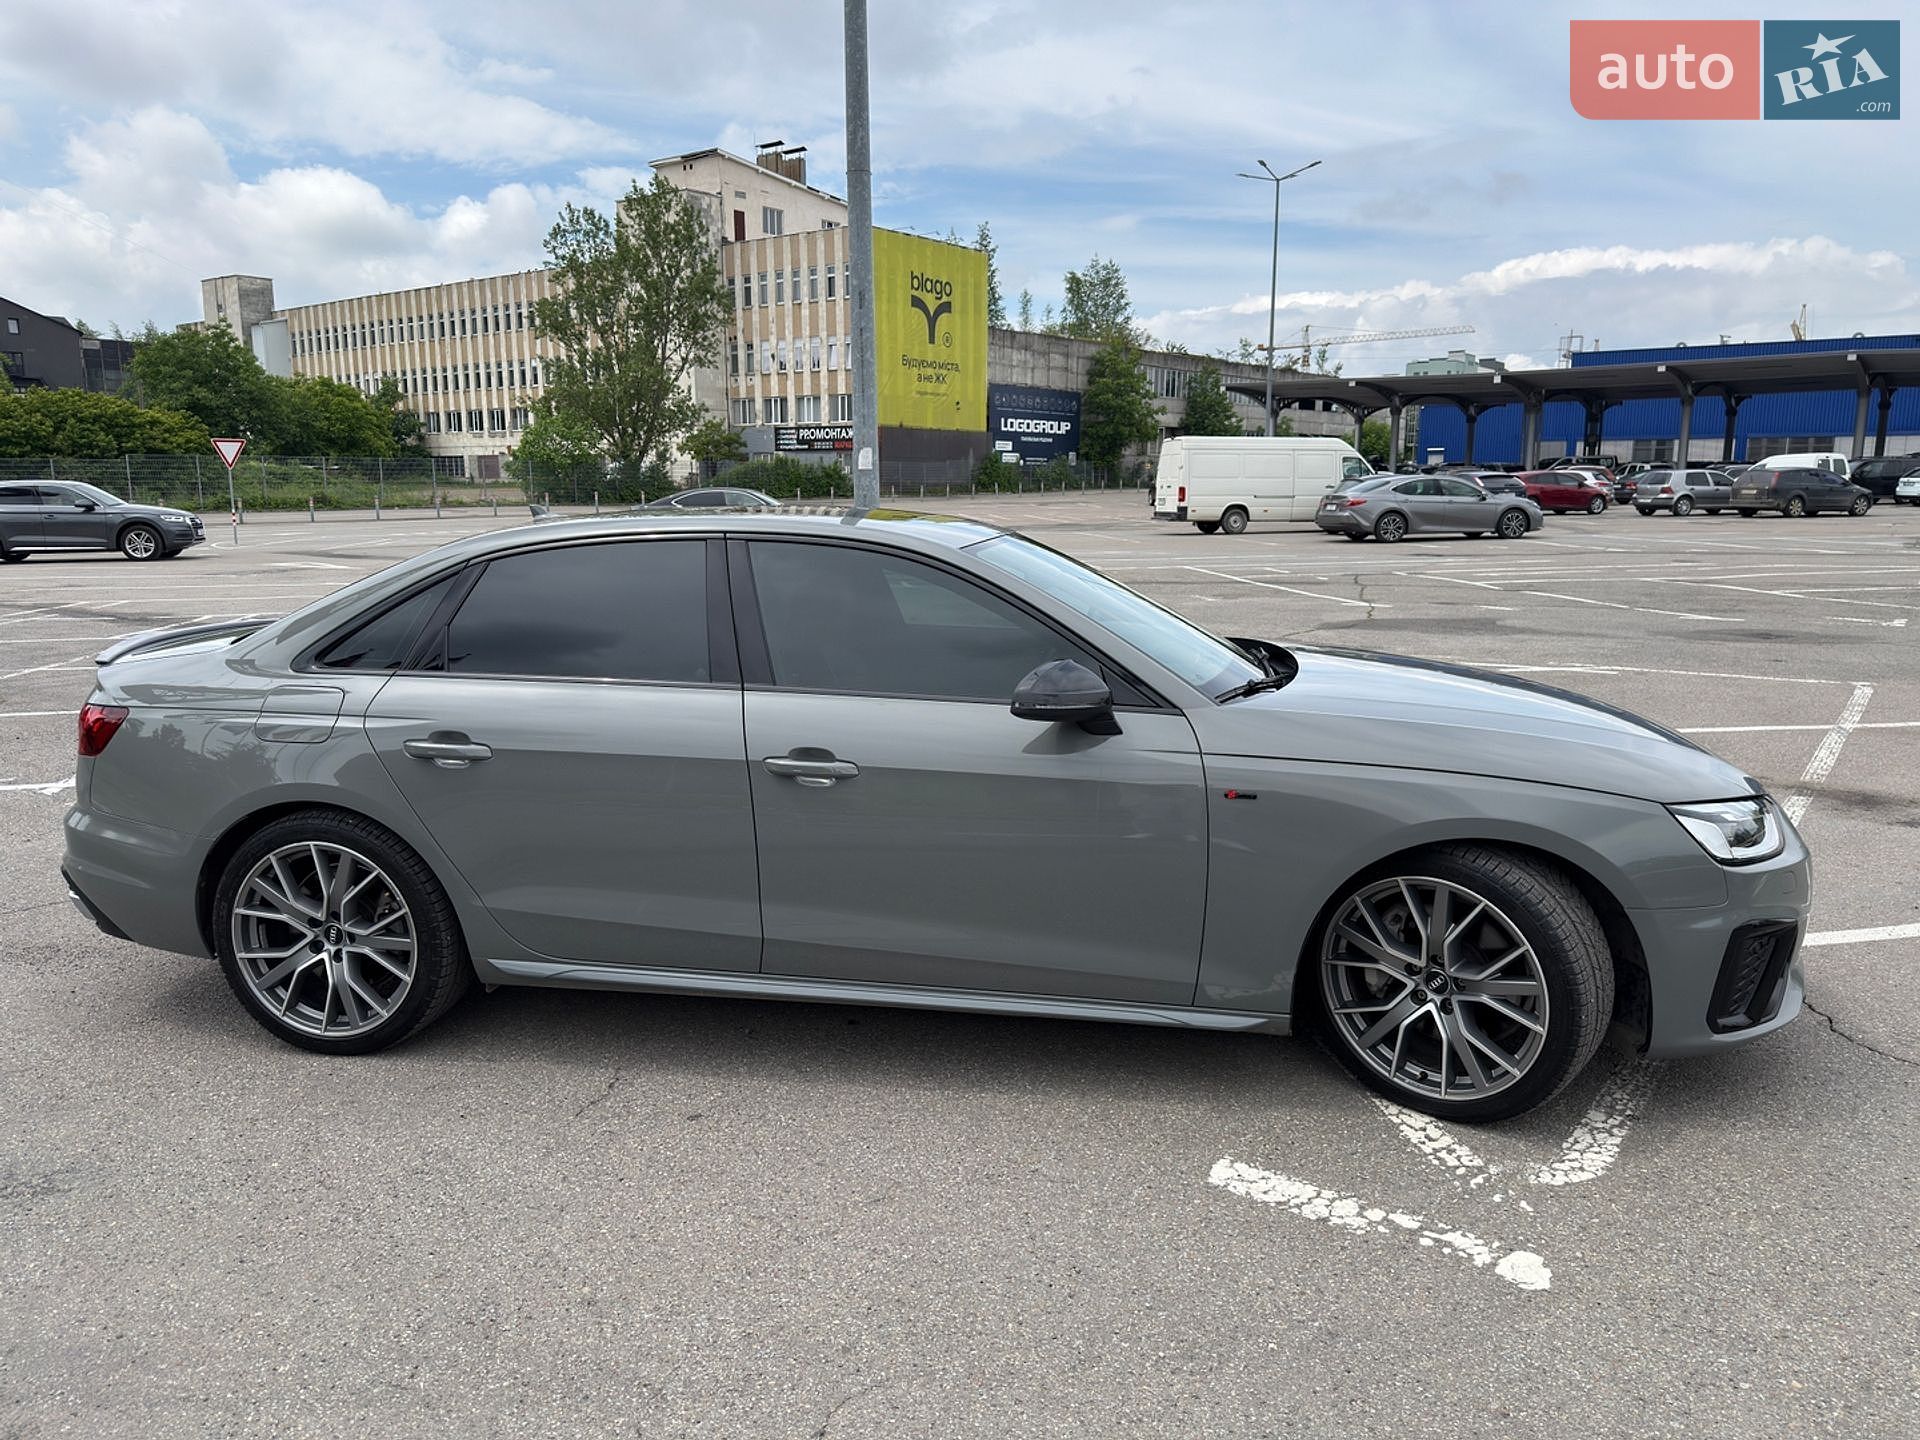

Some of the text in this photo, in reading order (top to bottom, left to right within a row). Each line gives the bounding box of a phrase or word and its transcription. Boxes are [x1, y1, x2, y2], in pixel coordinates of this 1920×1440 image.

[911, 270, 953, 300] blago
[902, 354, 938, 370] Будуємо
[934, 373, 948, 384] ЖК
[1001, 417, 1071, 435] LOGOGROUP
